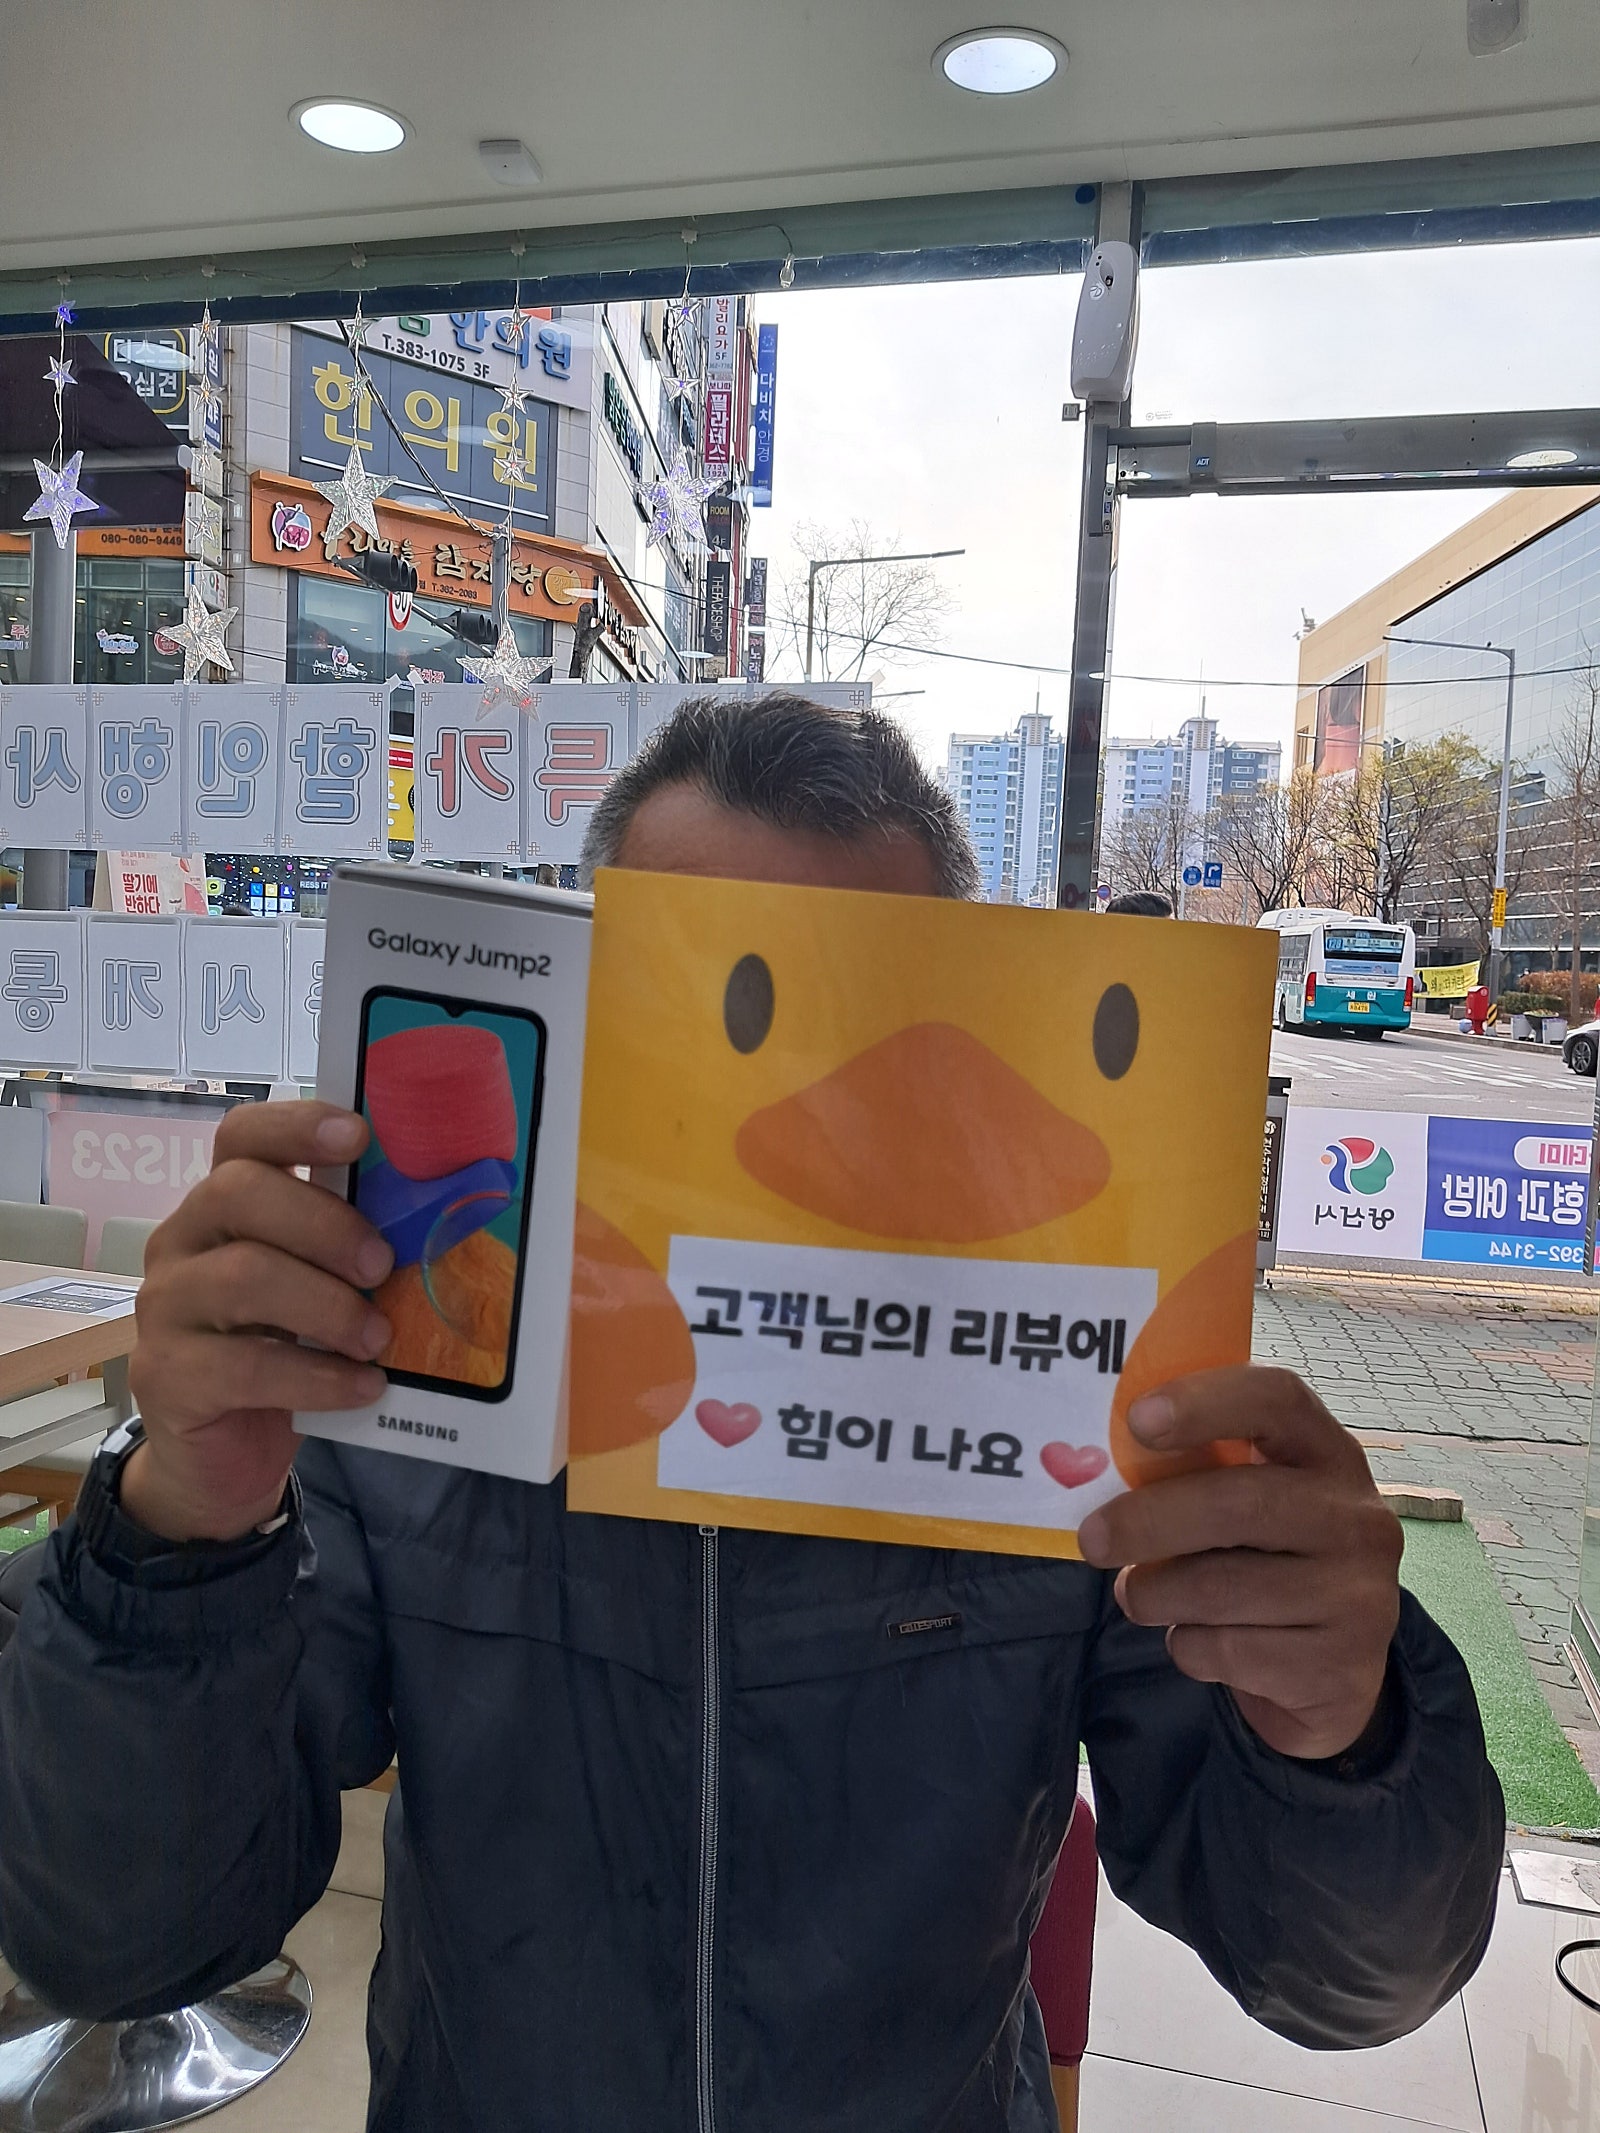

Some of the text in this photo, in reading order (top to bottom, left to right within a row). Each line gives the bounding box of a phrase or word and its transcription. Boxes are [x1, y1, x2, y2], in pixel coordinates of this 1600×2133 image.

[382, 333, 491, 380] T.383-1075 3F
[449, 312, 572, 381] 한의원
[715, 352, 728, 361] 5F
[757, 372, 775, 425] 다비치
[312, 361, 538, 493] 한의원
[708, 394, 730, 461] 필라테스
[757, 429, 773, 463] 안경
[1196, 458, 1210, 467] ADT
[710, 506, 730, 516] ROOM
[101, 533, 183, 546] 080-080-9449
[122, 873, 159, 894] 딸기에
[124, 894, 161, 914] 반하다
[367, 927, 552, 980] Galaxy Jump2
[690, 1285, 1127, 1375] 고객님의 리뷰에
[377, 1414, 459, 1442] SAMSUNG
[778, 1403, 1024, 1479] 힘이 나요
